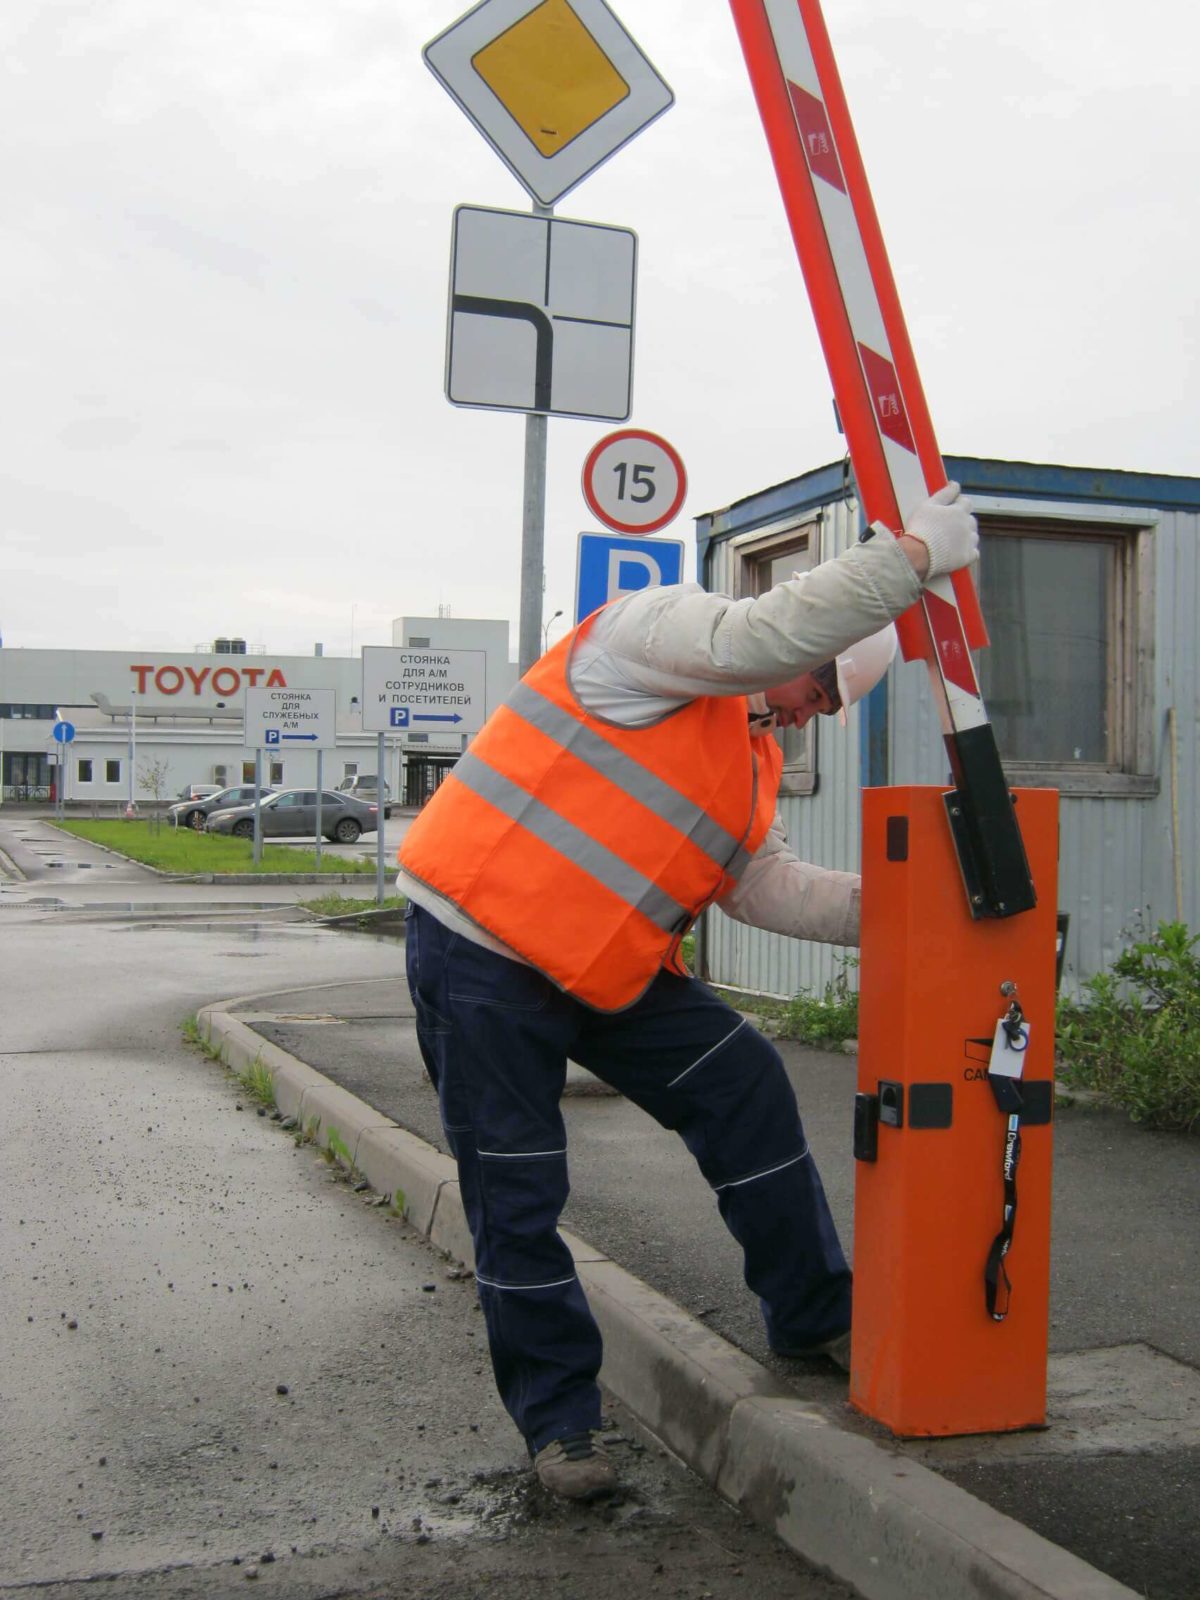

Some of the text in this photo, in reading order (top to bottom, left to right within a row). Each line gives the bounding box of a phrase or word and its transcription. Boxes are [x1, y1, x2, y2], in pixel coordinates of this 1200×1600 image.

[613, 462, 656, 503] 15
[607, 549, 661, 603] P
[400, 655, 450, 665] СТОЯНКА
[402, 668, 448, 678] ДЛЯ А/М
[130, 665, 287, 696] TOYOTA
[385, 681, 465, 692] СОТРУДНИКОВ
[270, 692, 312, 701] СТОЯНКА
[378, 694, 472, 705] И ПОСЕТИТЕЛЕЙ
[281, 702, 300, 711] ДЛЯ
[262, 711, 319, 720] СЛУЖЕБНЫХ
[394, 710, 406, 725] P
[283, 721, 299, 729] А/М
[268, 731, 278, 743] P
